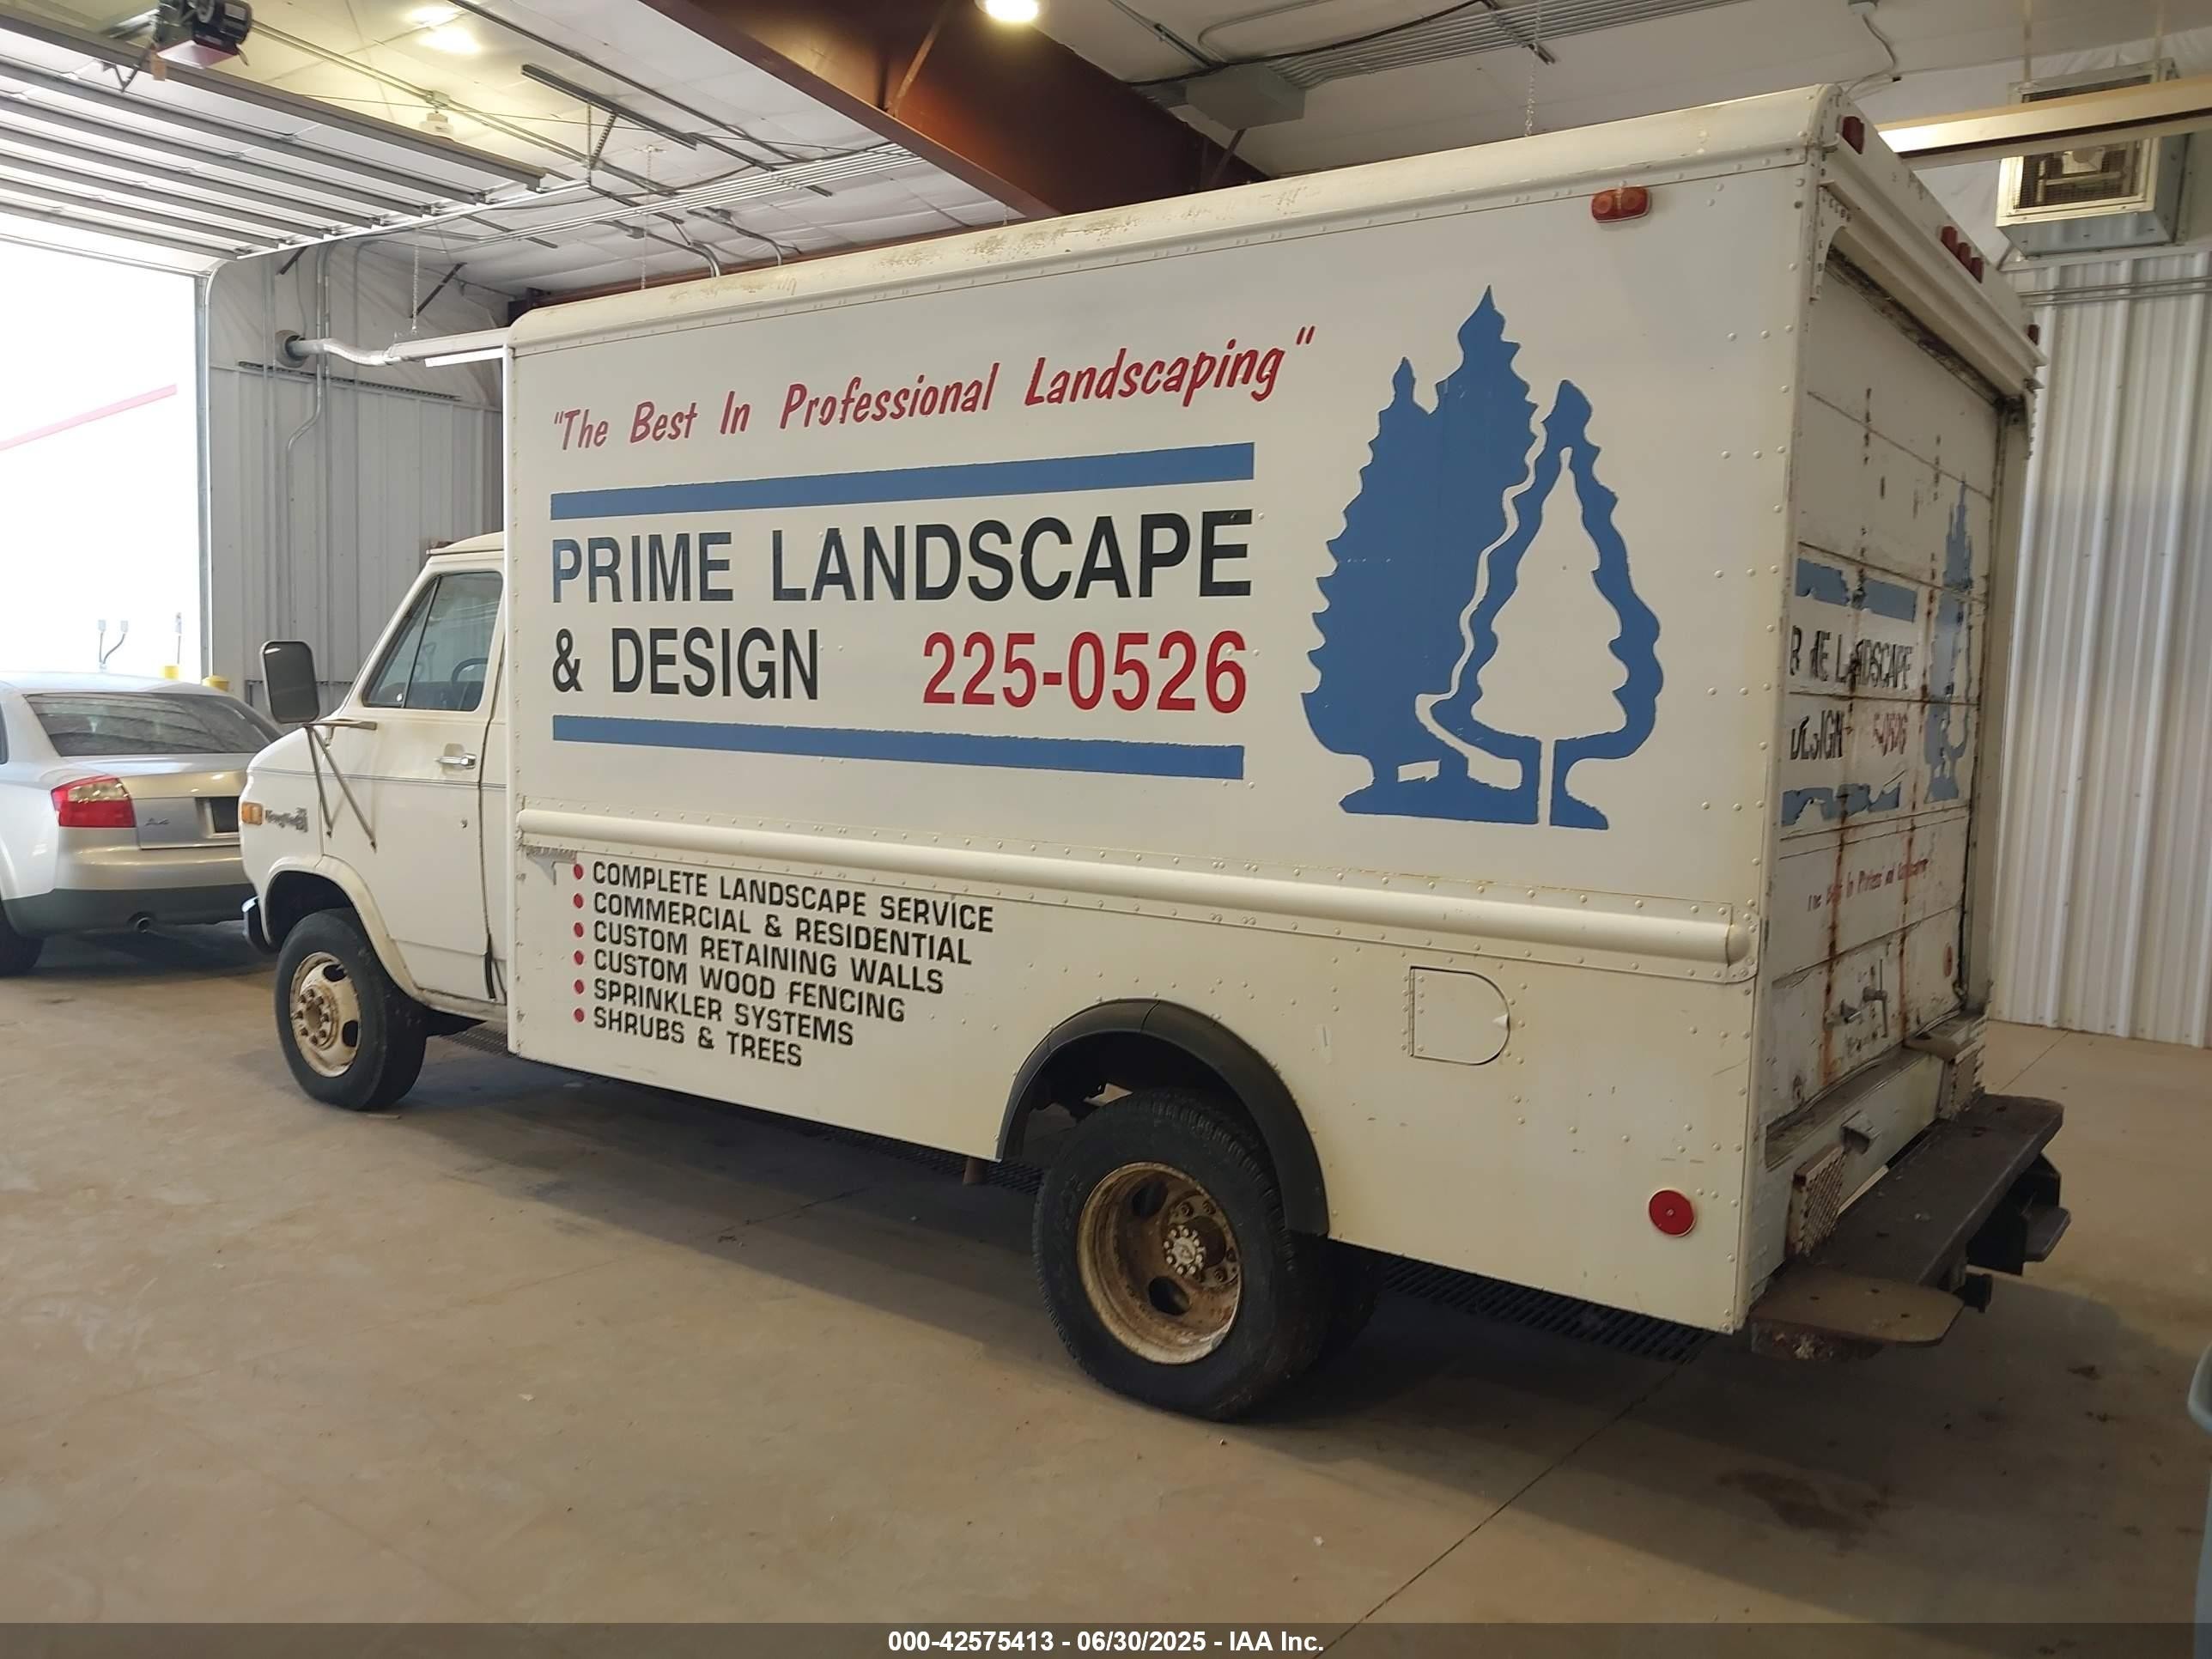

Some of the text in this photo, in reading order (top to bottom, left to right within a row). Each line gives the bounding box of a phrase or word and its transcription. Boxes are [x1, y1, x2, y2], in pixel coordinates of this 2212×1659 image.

[553, 325, 1316, 451] "The Best In Professional Landscaping"
[551, 508, 1253, 604] PRIME LANDSCAPE
[552, 627, 819, 701] & DESIGN
[922, 629, 1248, 714] 225-0526
[593, 860, 994, 933] COMPLETE LANDSCAPE SERVICE
[593, 892, 972, 966] COMMERCIAL & RESIDENTIAL
[593, 921, 944, 995] CUSTOM RETAINING WALLS
[593, 948, 905, 1023] CUSTOM WOOD FENCING
[593, 977, 854, 1047] SPRINKLER SYSTEMS
[593, 1006, 802, 1068] SHRUBS & TREES
